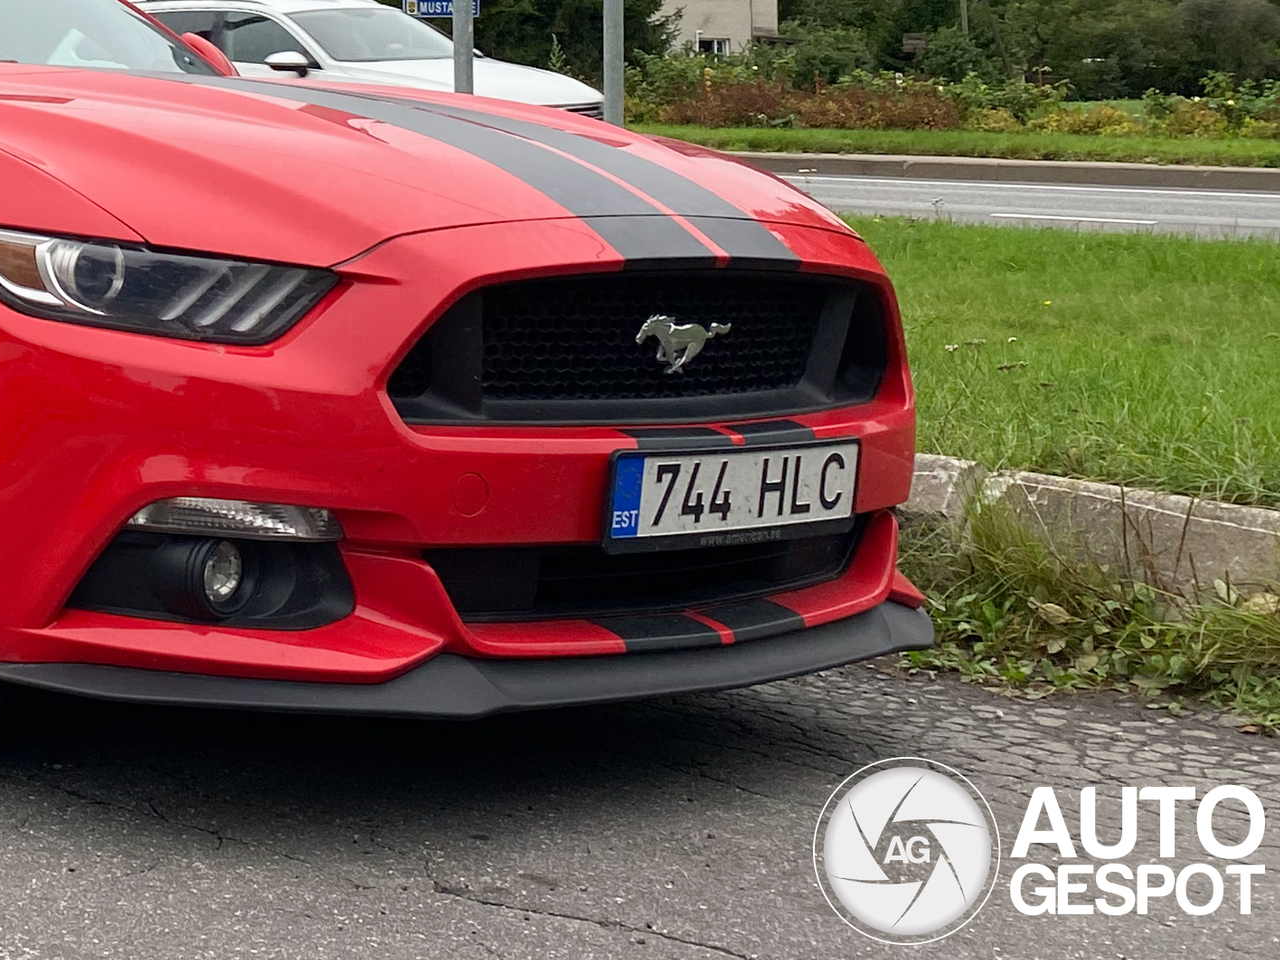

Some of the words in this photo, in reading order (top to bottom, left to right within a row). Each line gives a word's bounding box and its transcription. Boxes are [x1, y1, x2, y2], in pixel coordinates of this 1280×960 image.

[419, 2, 476, 13] MUSTAE
[651, 461, 731, 526] 744
[757, 452, 846, 518] HLC
[612, 510, 638, 529] EST
